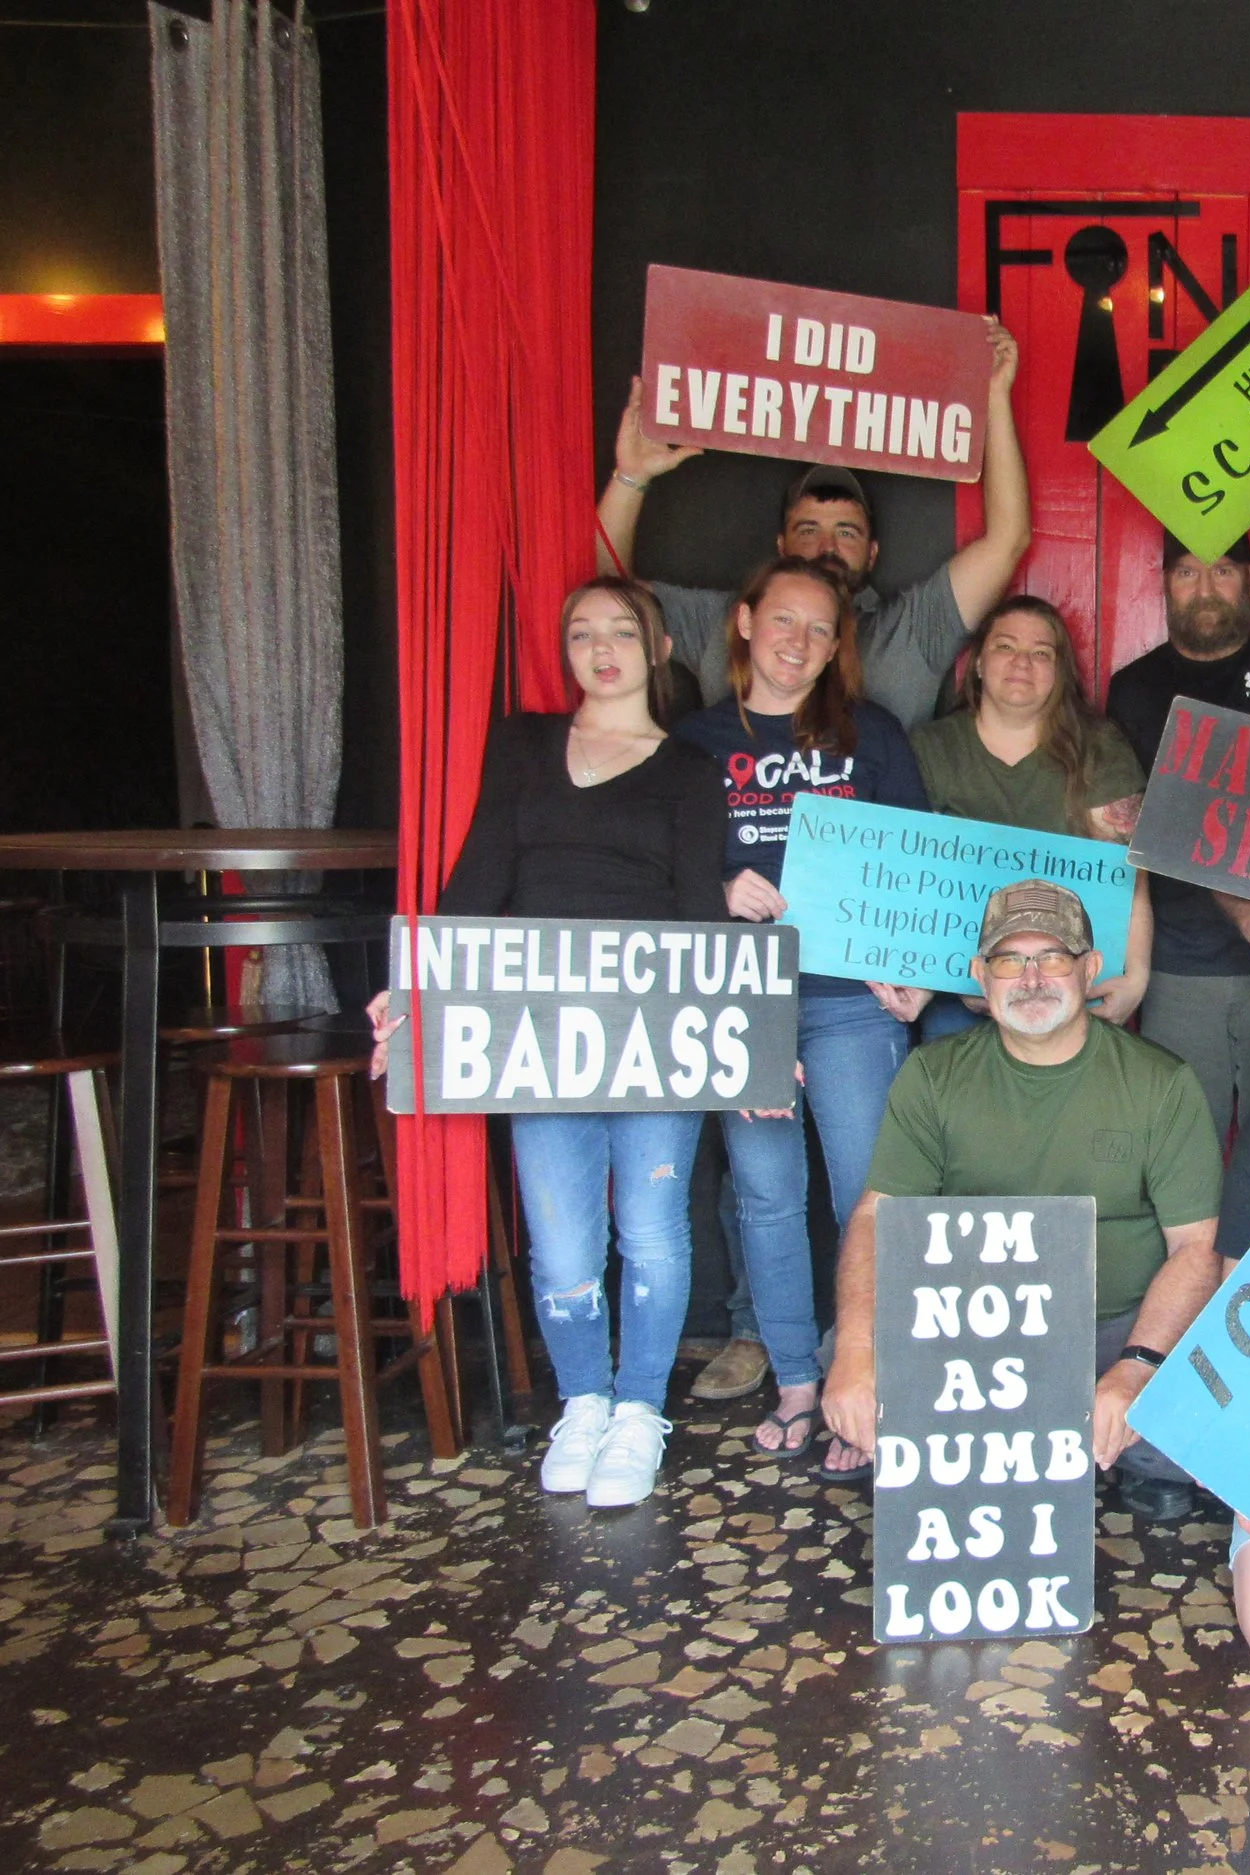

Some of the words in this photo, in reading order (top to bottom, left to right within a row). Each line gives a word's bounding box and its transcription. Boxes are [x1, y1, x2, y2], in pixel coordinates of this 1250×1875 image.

[766, 313, 783, 362] I
[794, 317, 876, 375] DID
[655, 364, 972, 463] EVERYTHING
[724, 749, 854, 791] OCAL!
[728, 792, 774, 806] OOD
[782, 785, 855, 803] DNOR
[733, 808, 757, 818] here
[759, 806, 792, 816] becau
[798, 812, 894, 851] Never
[900, 828, 1126, 888] Underestimate
[861, 860, 911, 895] the
[918, 869, 1002, 904] Pow
[835, 897, 940, 939] Stupid
[399, 926, 793, 995] INTELLECTUAL
[845, 937, 937, 977] Large
[440, 1005, 750, 1099] BADASS
[924, 1211, 1039, 1264] I'M
[911, 1283, 1052, 1339] NOT
[934, 1357, 1028, 1411] AS
[1188, 1343, 1234, 1411] I
[875, 1429, 1089, 1488] DUMB
[906, 1504, 1005, 1561] AS
[1029, 1503, 1057, 1555] I
[885, 1575, 1079, 1637] LOOK
